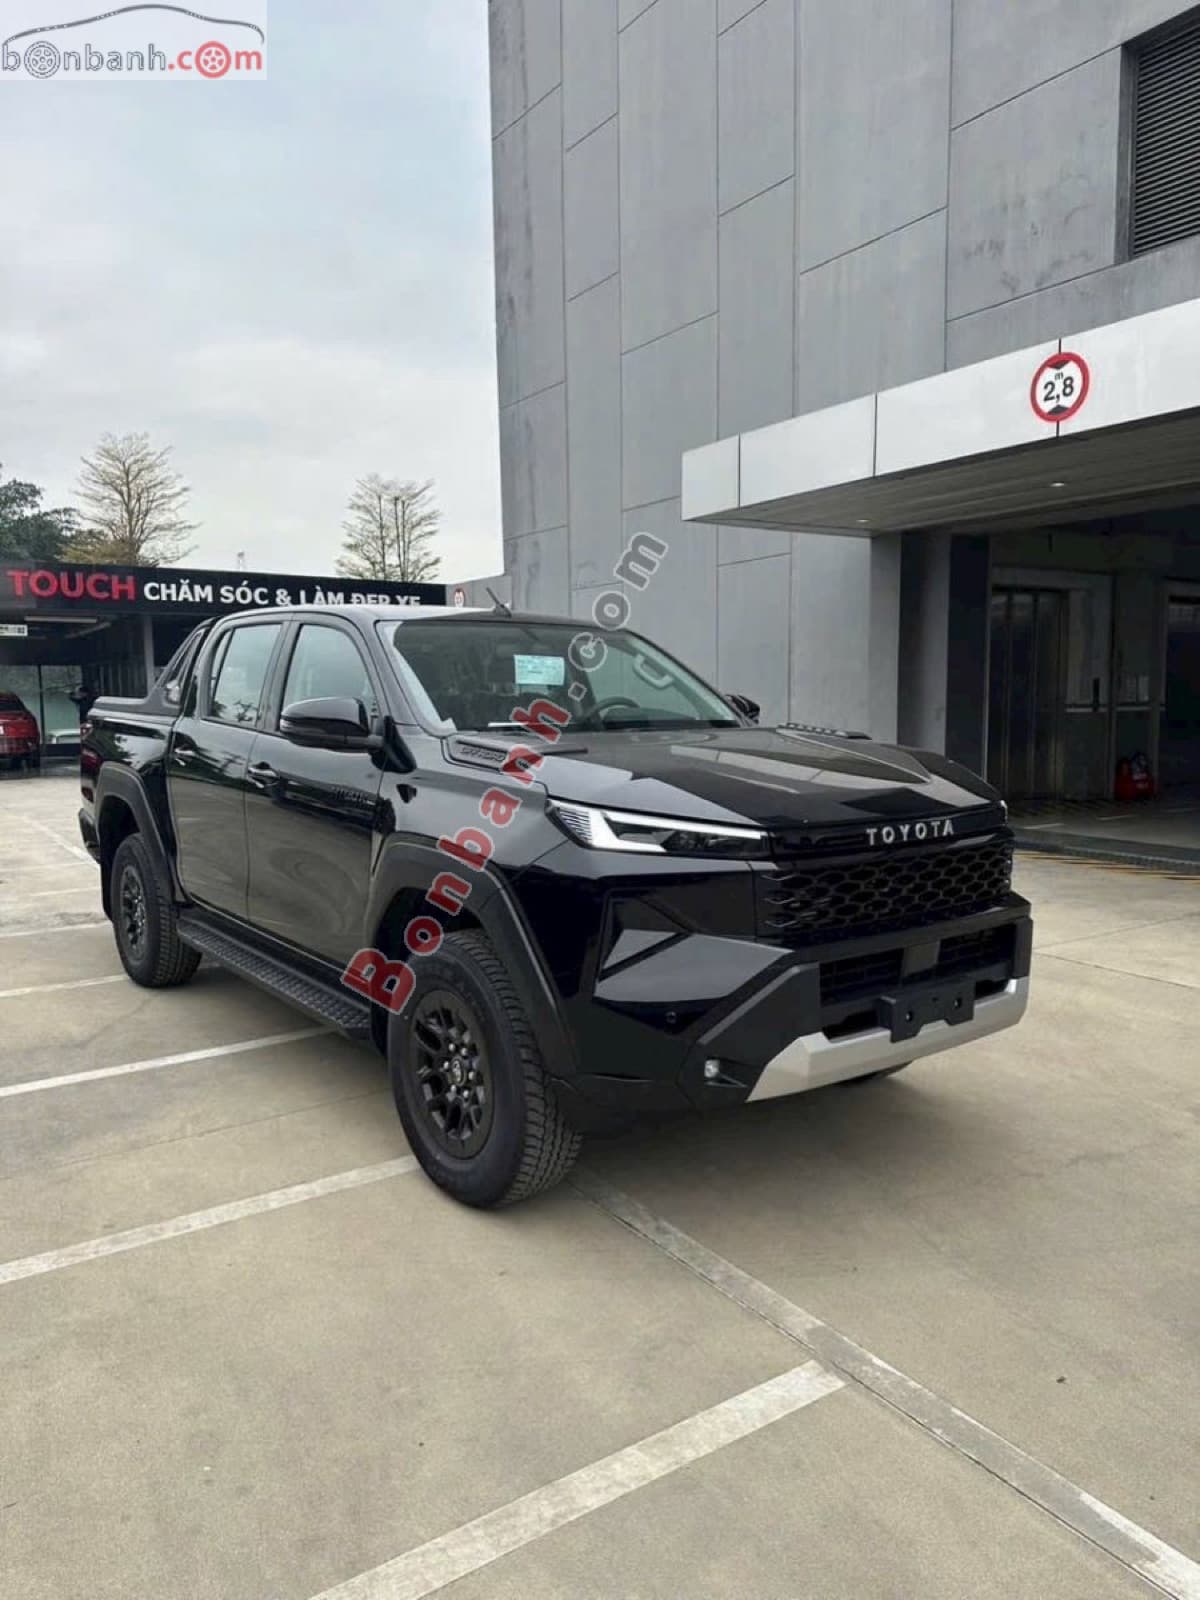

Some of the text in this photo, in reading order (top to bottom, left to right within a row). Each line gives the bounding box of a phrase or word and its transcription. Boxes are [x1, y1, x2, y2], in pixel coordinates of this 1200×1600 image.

[1043, 376, 1075, 403] 2,8
[7, 569, 138, 600] TOUCH
[143, 579, 214, 603] CHĂM
[219, 580, 269, 605] SÓC
[275, 588, 292, 607] &
[866, 819, 954, 846] TOYOTA
